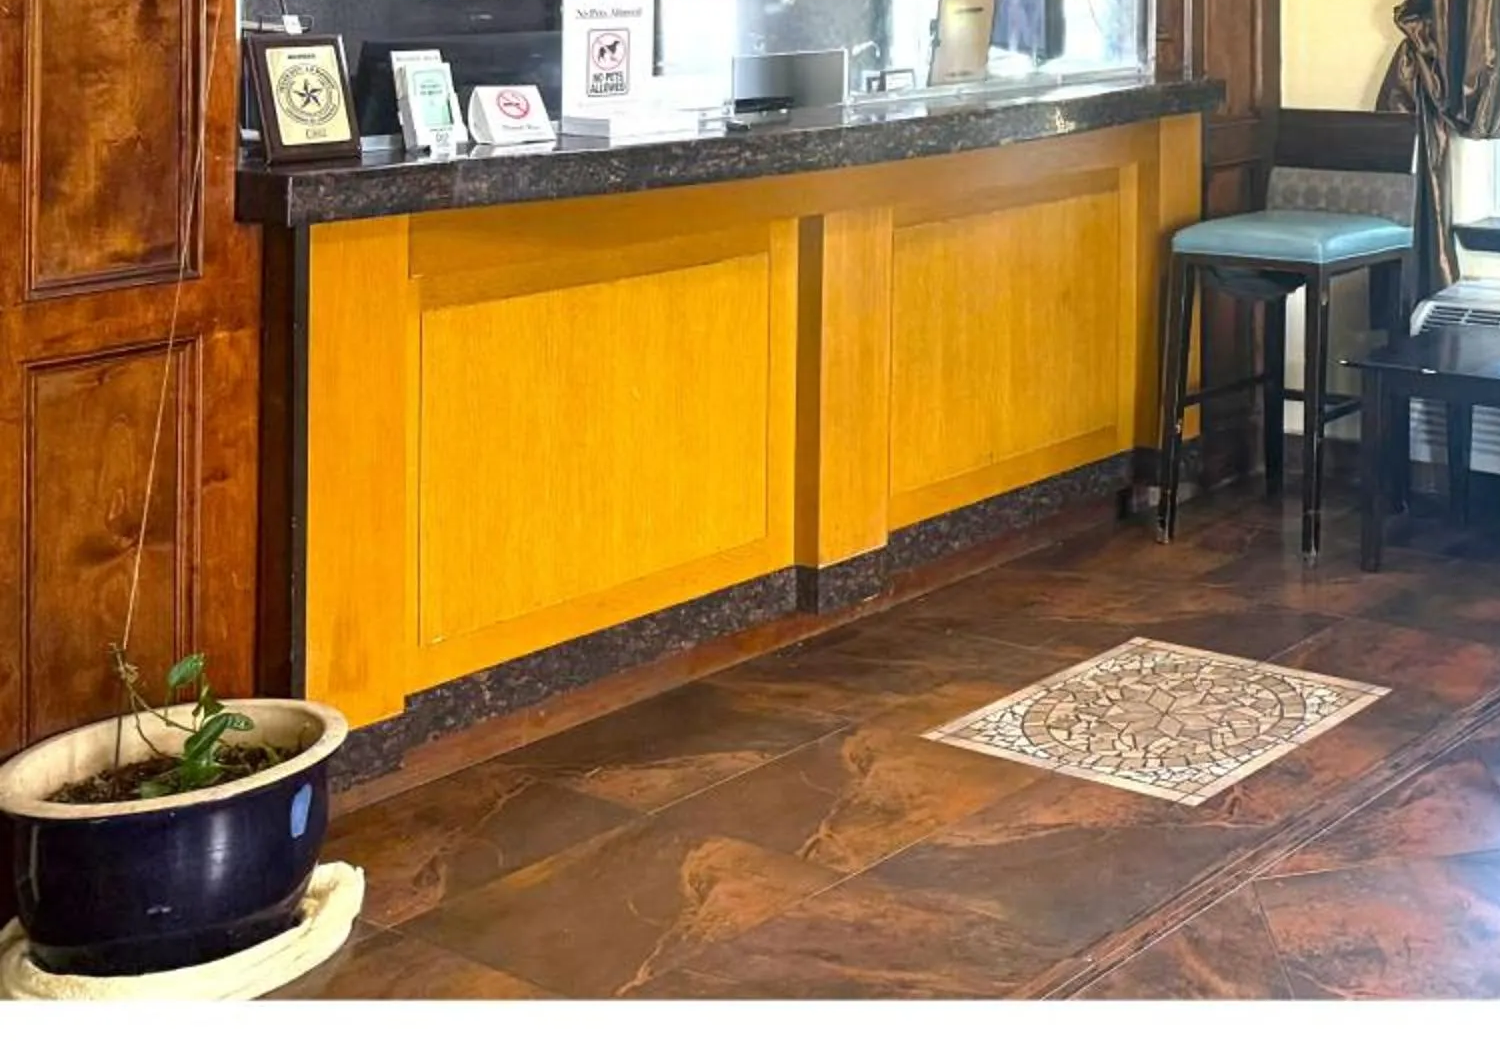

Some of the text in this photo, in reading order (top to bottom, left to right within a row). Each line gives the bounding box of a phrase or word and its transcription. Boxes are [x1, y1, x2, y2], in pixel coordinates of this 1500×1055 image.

[592, 71, 624, 82] NO PETS
[590, 82, 626, 93] ALLOWED
